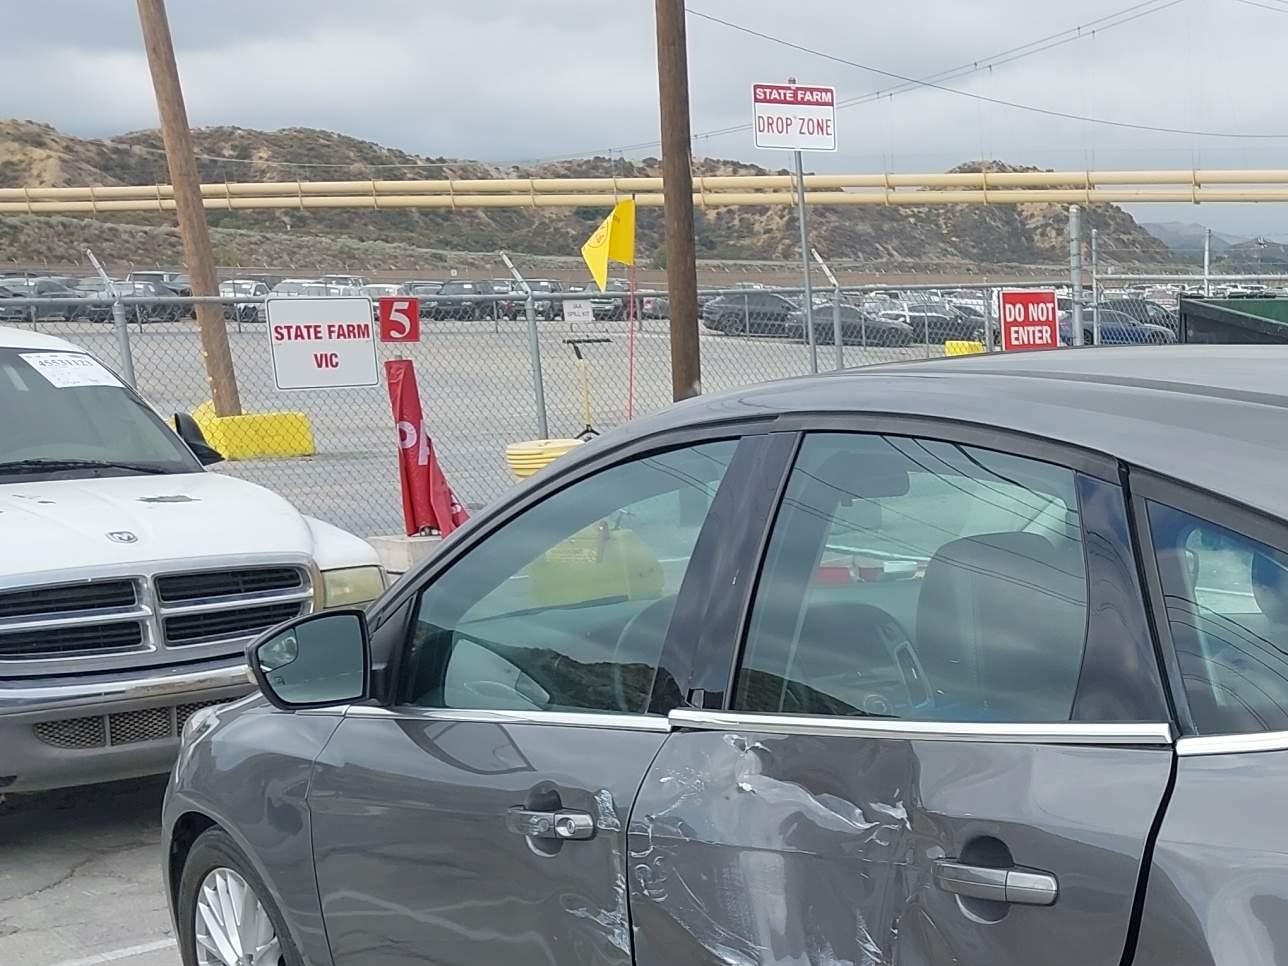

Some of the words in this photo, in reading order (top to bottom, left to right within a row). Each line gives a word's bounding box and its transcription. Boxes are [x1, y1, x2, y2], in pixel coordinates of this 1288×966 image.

[756, 88, 795, 101] STATE
[797, 90, 832, 103] FARM
[757, 115, 793, 134] DROP
[798, 117, 833, 136] ZONE
[389, 301, 411, 338] 5
[1005, 303, 1025, 322] DO
[1028, 302, 1054, 322] NOT
[273, 325, 323, 341] STATE
[327, 323, 371, 340] FARM
[1010, 326, 1052, 345] ENTER
[313, 353, 340, 369] VIC
